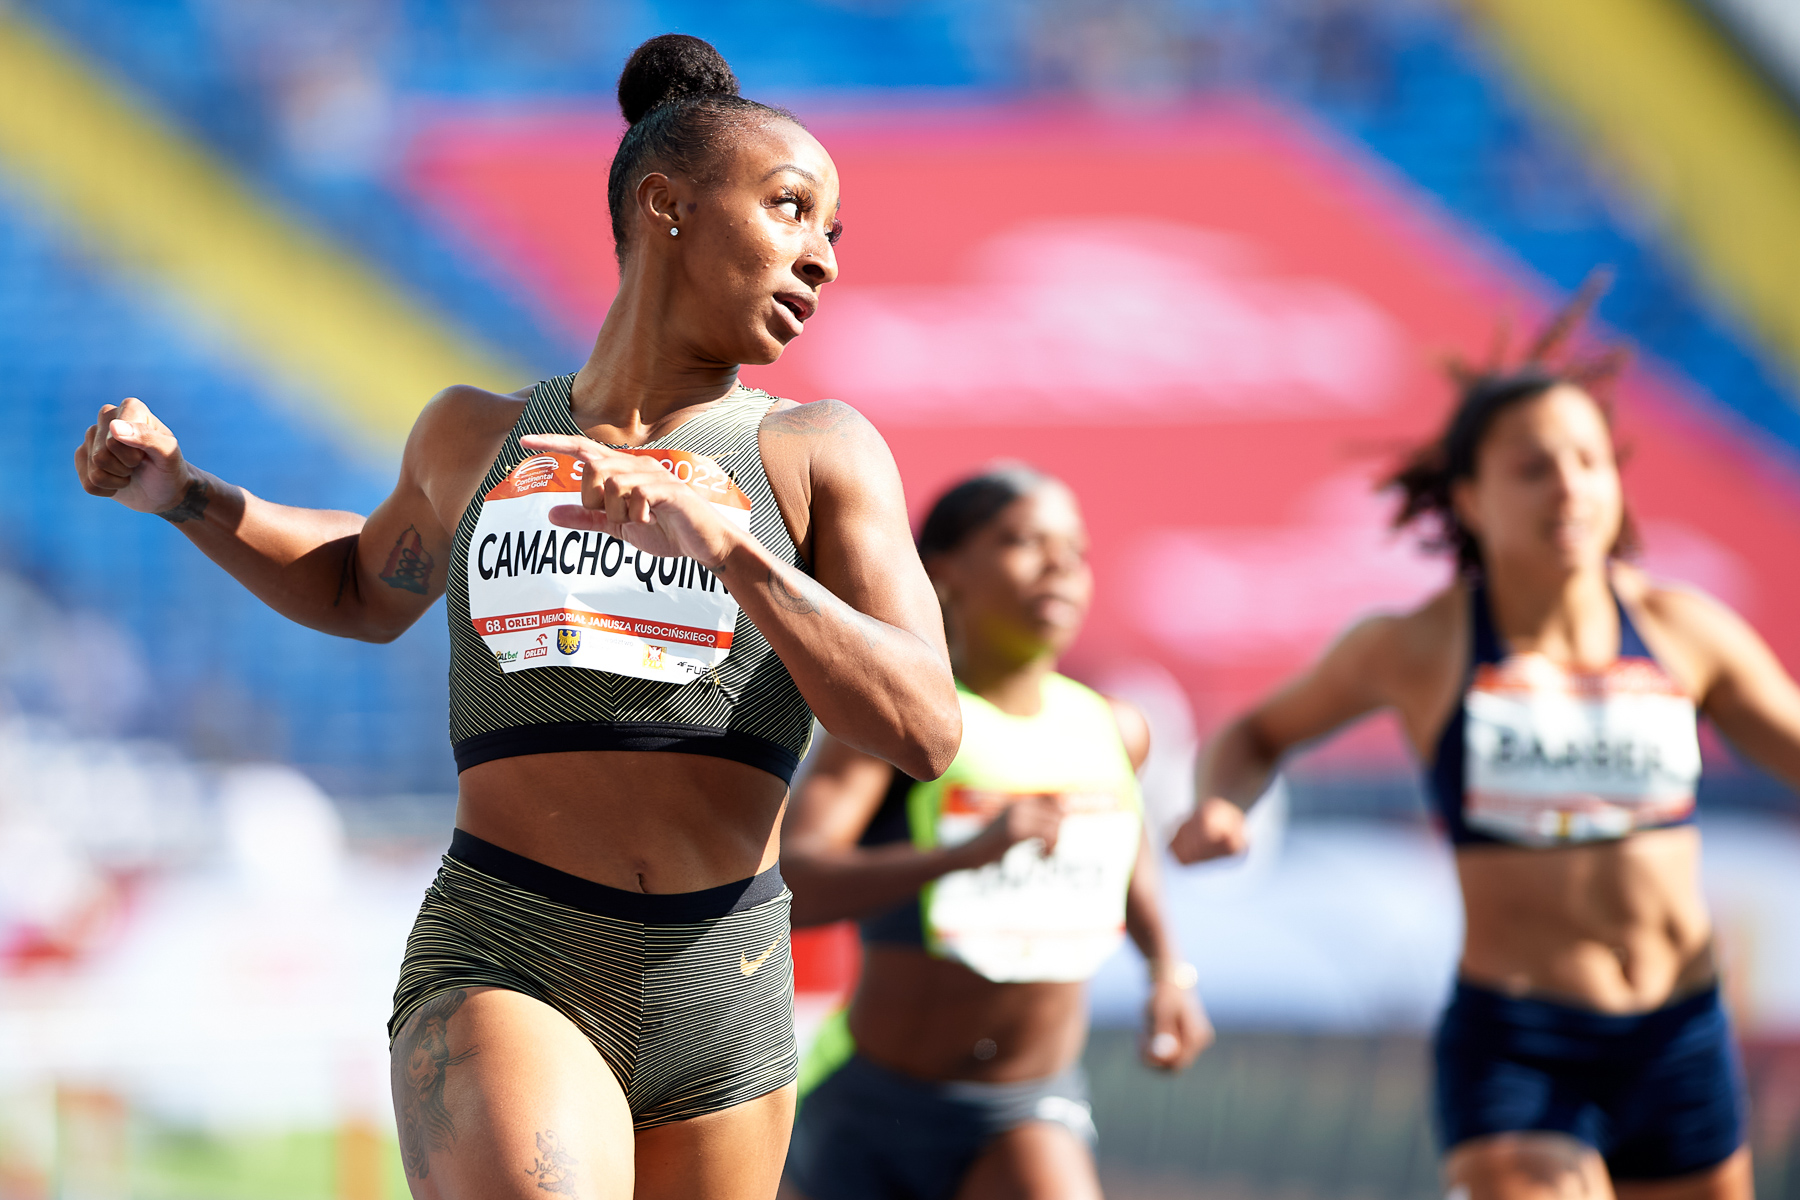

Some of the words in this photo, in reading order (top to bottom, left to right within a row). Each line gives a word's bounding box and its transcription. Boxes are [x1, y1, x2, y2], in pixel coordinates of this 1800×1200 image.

[515, 472, 554, 487] Continental
[517, 484, 531, 493] Tour
[530, 479, 549, 489] Gold
[477, 530, 729, 595] CAMACHO-QUIN
[485, 619, 505, 633] 68.
[507, 616, 538, 629] ORLEN
[541, 612, 586, 625] MEMORIAŁ
[587, 616, 632, 632] JANUSZA
[634, 623, 716, 644] KUSOCIŃSKIEGO
[525, 648, 546, 657] ORLEN
